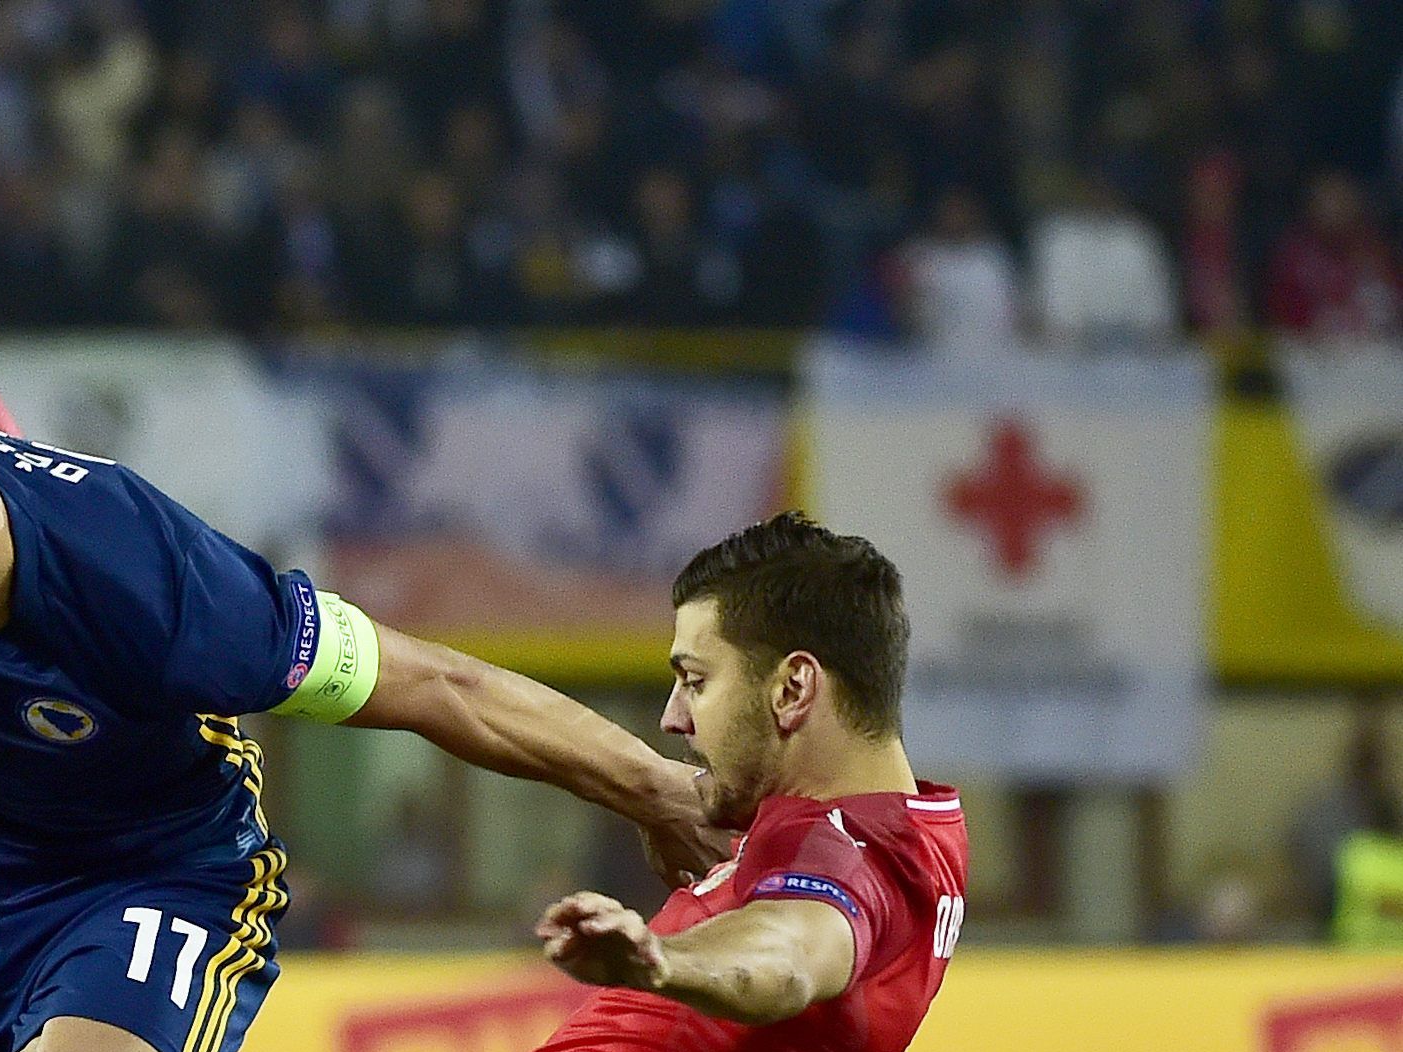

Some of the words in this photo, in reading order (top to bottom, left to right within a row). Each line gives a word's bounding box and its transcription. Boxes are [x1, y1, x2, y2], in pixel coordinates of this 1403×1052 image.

[298, 583, 315, 662] RESPECT
[326, 600, 354, 674] RESPECT
[123, 906, 209, 1010] 11
